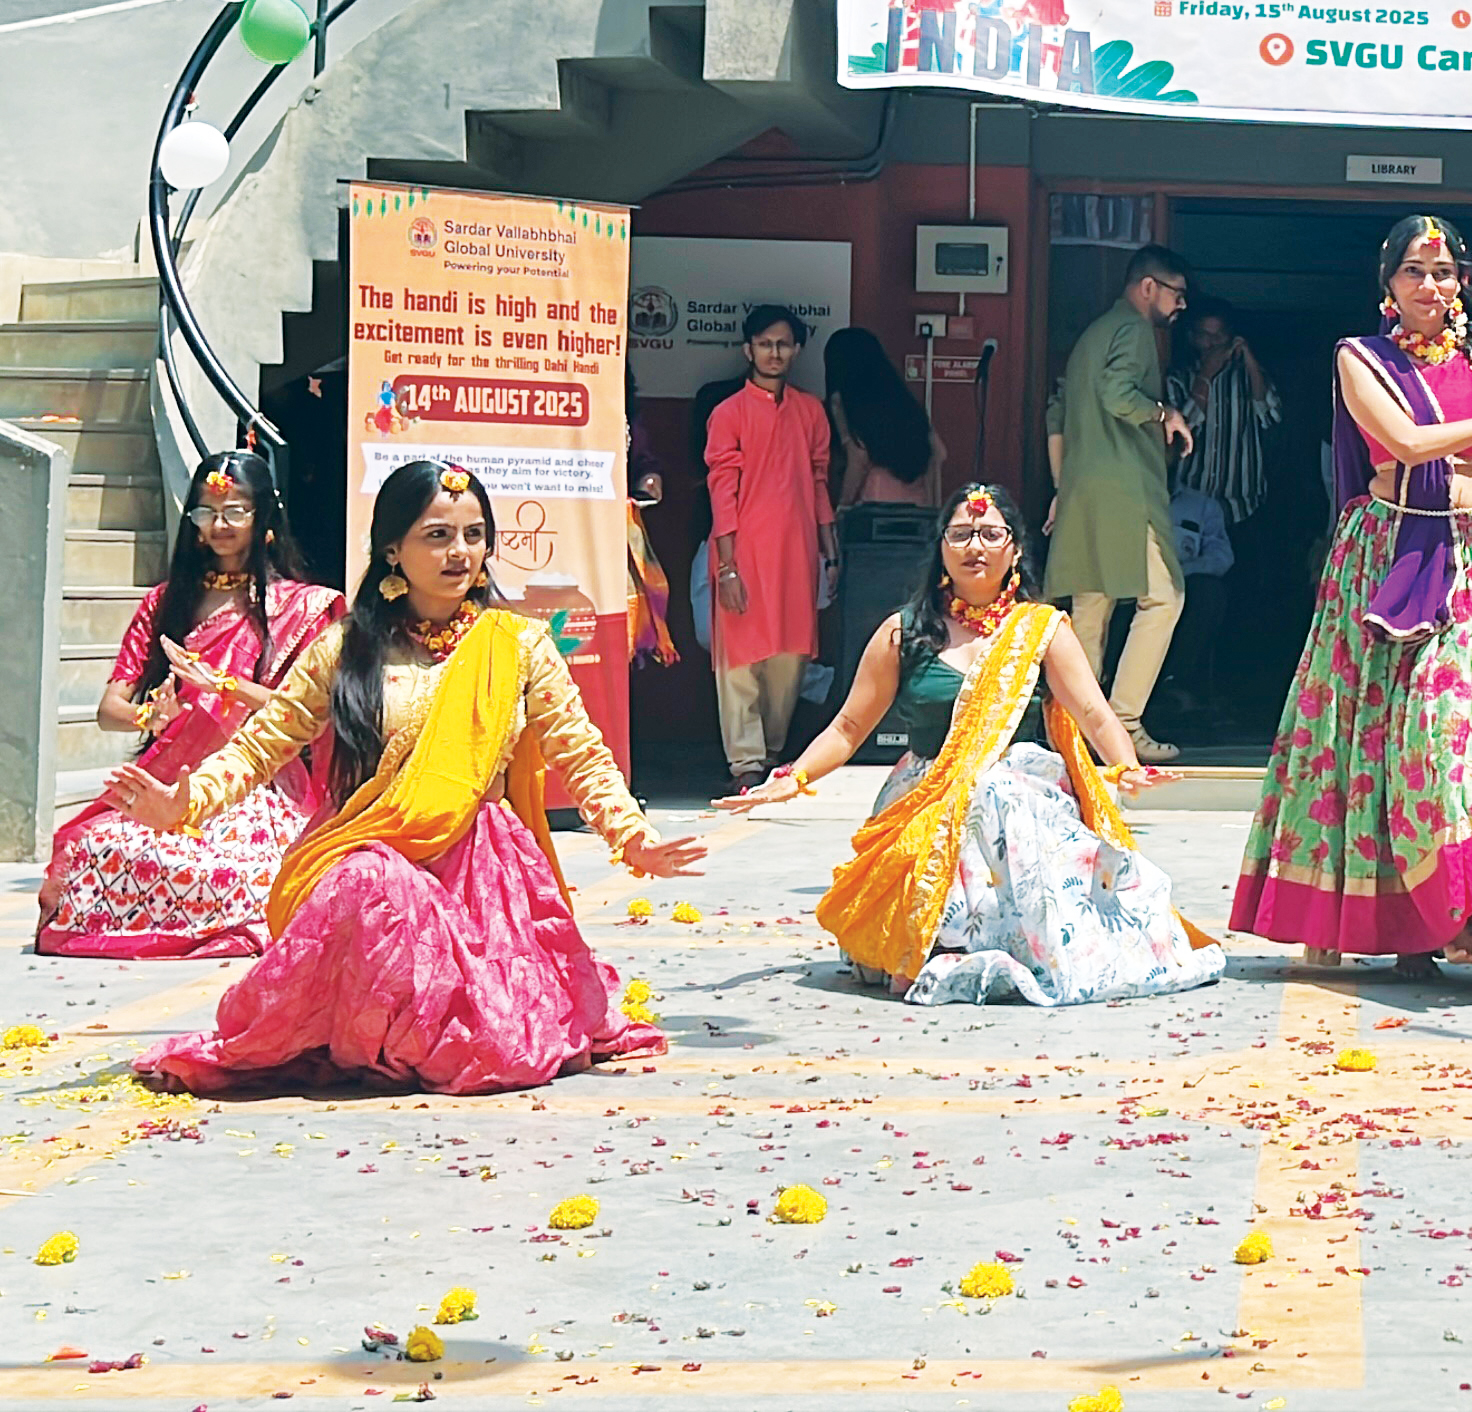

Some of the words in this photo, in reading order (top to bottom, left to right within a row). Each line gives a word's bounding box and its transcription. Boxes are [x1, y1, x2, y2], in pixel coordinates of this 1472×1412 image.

[1179, 1, 1250, 20] Friday,
[1298, 5, 1371, 24] August
[1375, 9, 1429, 25] 2025
[885, 8, 1095, 94] INDIA
[1306, 39, 1403, 69] SVGU
[1371, 164, 1417, 175] LIBRARY
[444, 219, 491, 237] Sardar
[496, 225, 577, 244] Vallabhbhai
[444, 240, 490, 256] Global
[495, 245, 566, 265] University
[444, 261, 493, 274] Powering
[497, 266, 520, 275] your
[523, 266, 569, 278] Potential
[359, 285, 393, 309] The
[404, 287, 457, 313] handi
[468, 292, 485, 315] is
[496, 294, 536, 323] high
[547, 300, 580, 321] and
[590, 302, 617, 325] the
[686, 301, 738, 315] Sardar
[686, 318, 736, 333] Global
[354, 319, 464, 345] excitement
[475, 324, 492, 347] is
[503, 331, 547, 350] even
[558, 330, 620, 358] higher!
[384, 350, 402, 363] Get
[408, 352, 441, 368] ready
[448, 353, 465, 366] for
[471, 355, 489, 368] the
[496, 356, 539, 373] thrilling
[545, 358, 567, 372] Dahi
[573, 360, 599, 374] Handi
[408, 384, 450, 411] 14th
[454, 386, 530, 415] AUGUST
[534, 389, 582, 417] 2025
[374, 452, 389, 461] Be
[403, 454, 426, 463] part
[445, 454, 463, 463] the
[467, 455, 504, 465] human
[508, 457, 551, 467] pyramid
[555, 458, 573, 466] and
[578, 458, 604, 468] cheer
[484, 466, 508, 477] they
[512, 467, 531, 476] aim
[535, 468, 549, 476] for
[554, 468, 593, 479] victory.
[501, 482, 530, 491] won't
[535, 483, 560, 492] want
